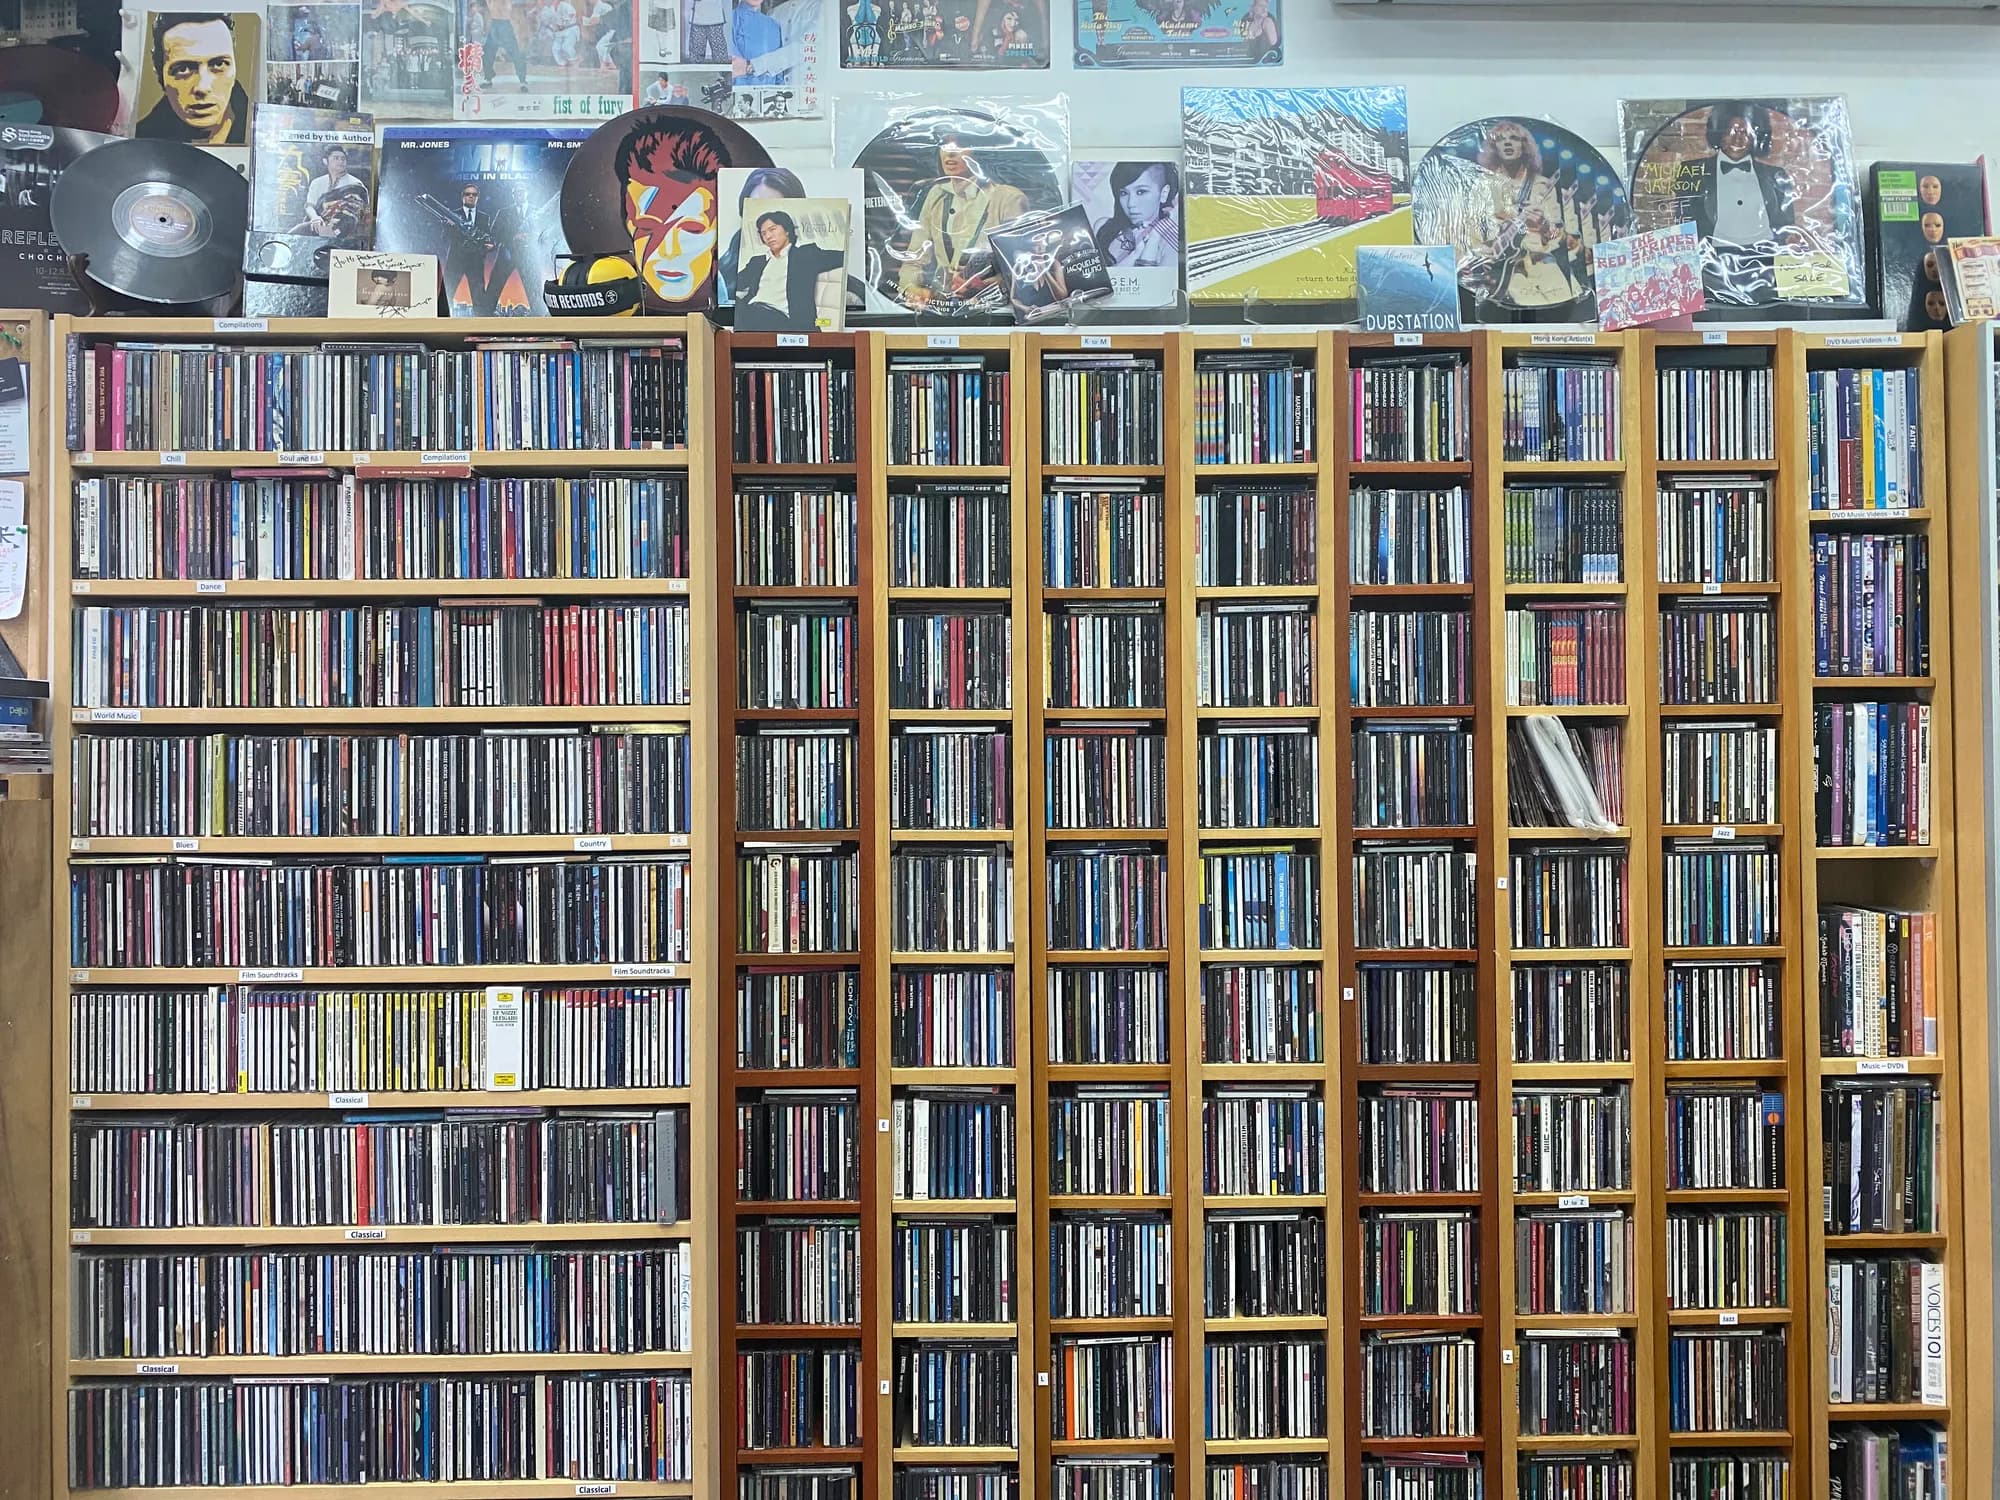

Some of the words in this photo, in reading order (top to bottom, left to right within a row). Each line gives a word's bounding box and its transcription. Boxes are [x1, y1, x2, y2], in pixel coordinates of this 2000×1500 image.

[553, 96, 572, 114] fist
[580, 96, 591, 114] of
[599, 96, 624, 116] fury
[312, 133, 323, 142] by
[325, 133, 339, 141] the
[342, 133, 372, 142] Author
[1644, 162, 1711, 178] MICHAEL
[456, 172, 480, 181] MEN
[482, 172, 496, 181] IN
[1645, 179, 1701, 194] JACKSON
[1658, 200, 1692, 217] OFF
[1629, 232, 1654, 250] THE
[1597, 254, 1627, 269] RED
[1811, 262, 1833, 270] FOR
[1793, 274, 1825, 283] SALE
[560, 291, 605, 308] RECORDS
[218, 320, 263, 331] Compilations
[1366, 313, 1455, 331] DUBSTATION
[782, 336, 788, 344] A
[1533, 336, 1549, 345] Hong
[1551, 336, 1567, 345] Kong
[1708, 333, 1721, 341] Jazz
[1827, 338, 1840, 346] DVD
[1860, 336, 1881, 344] Videos
[1908, 425, 1916, 448] FAITH
[166, 454, 182, 463] Chill
[279, 454, 295, 463] Soul
[295, 454, 310, 463] and
[422, 453, 467, 463] Compilations
[1832, 511, 1846, 520] DVD
[1847, 511, 1865, 519] Music
[1866, 510, 1888, 518] Videos
[200, 583, 222, 592] Dance
[1706, 584, 1718, 592] Jazz
[94, 711, 115, 720] World
[116, 711, 137, 720] Music
[1717, 829, 1730, 837] Jazz
[175, 840, 194, 849] Blues
[579, 838, 606, 849] Country
[242, 970, 255, 979] Film
[256, 970, 298, 979] Soundtracks
[614, 966, 627, 976] Film
[629, 966, 670, 976] Soundtracks
[846, 978, 854, 1002] BON
[1861, 1062, 1881, 1070] Music
[1887, 1062, 1905, 1070] DVDs
[335, 1096, 363, 1105] Classical
[350, 1230, 383, 1239] Classical
[1927, 1283, 1941, 1333] VOICES
[1927, 1335, 1941, 1359] 101
[1505, 1353, 1511, 1362] Z
[142, 1365, 175, 1374] Classical
[578, 1484, 612, 1494] Classical
